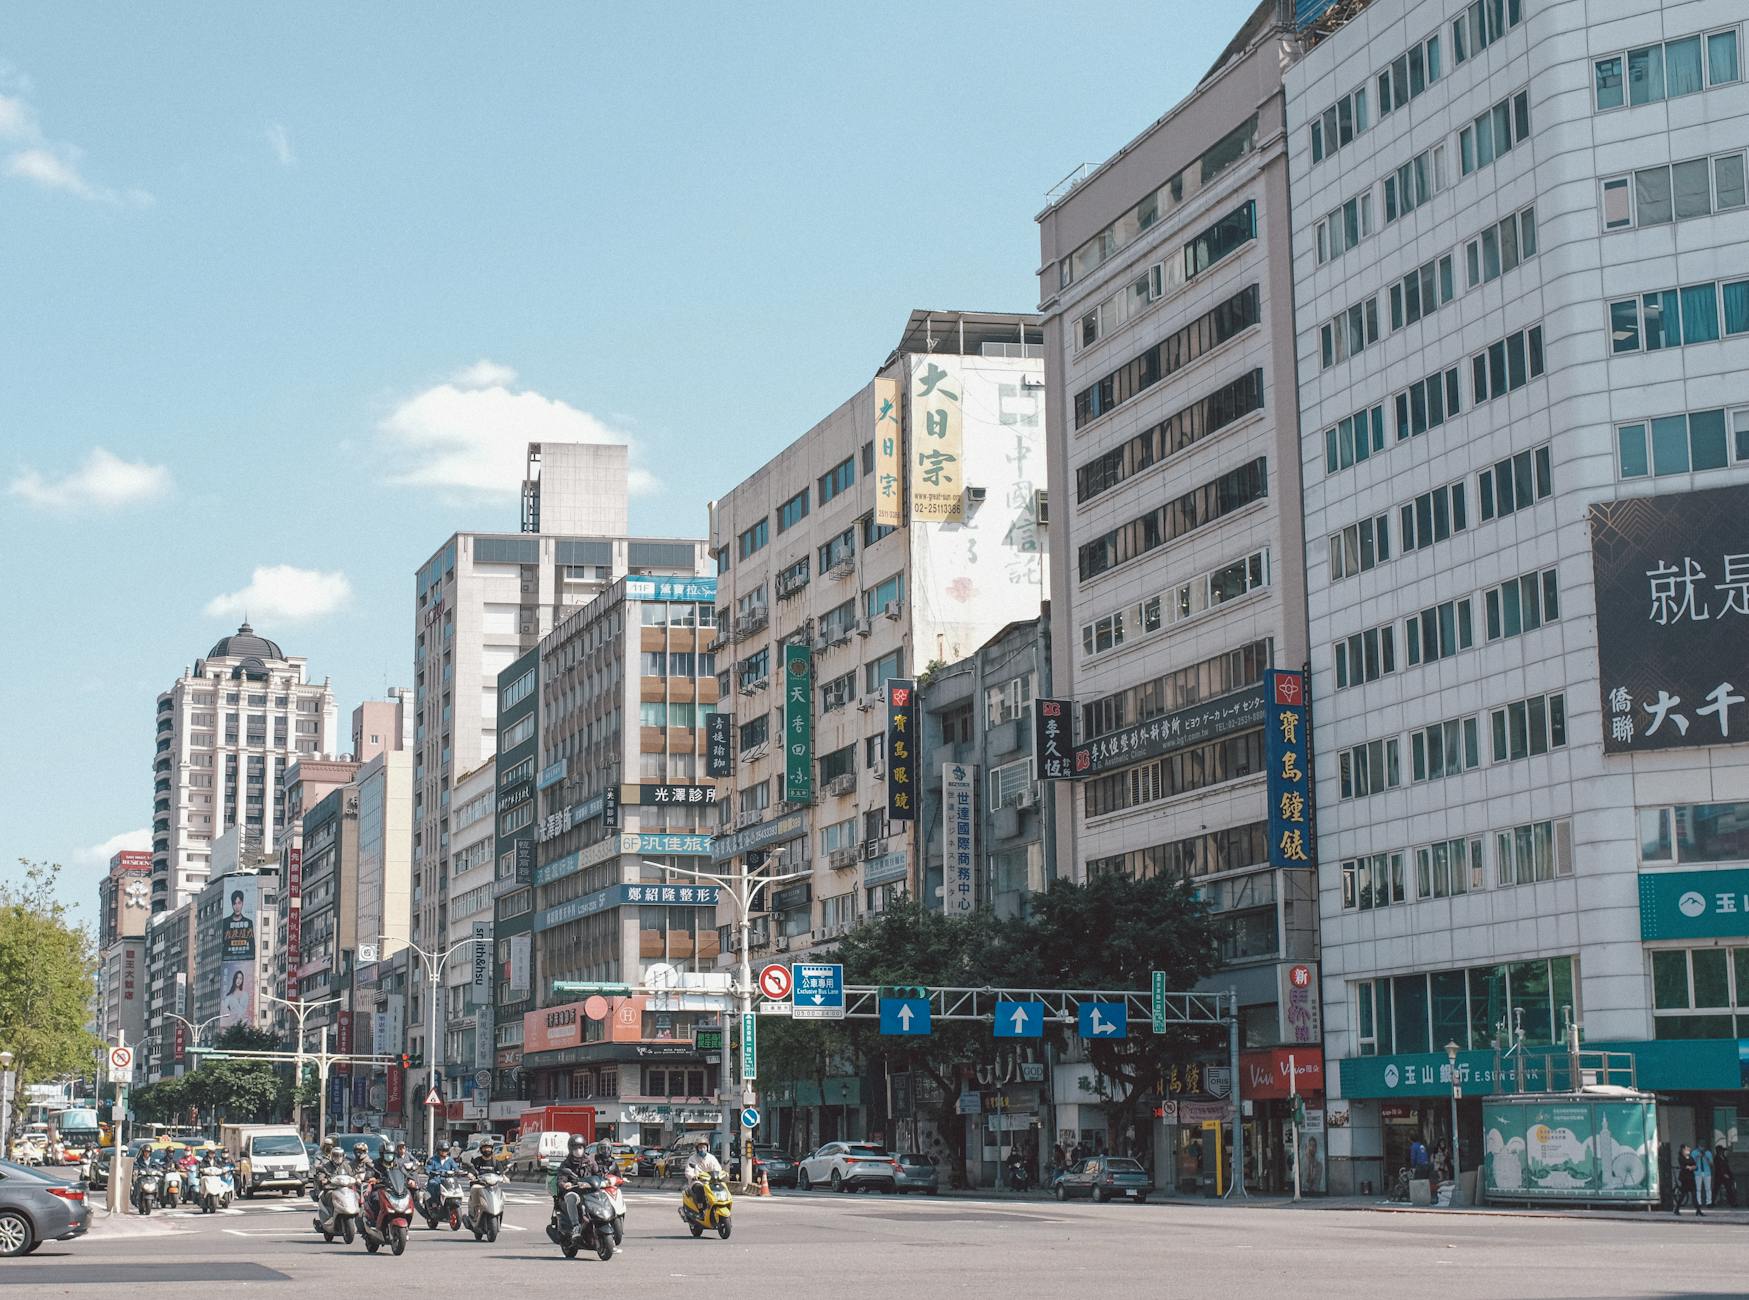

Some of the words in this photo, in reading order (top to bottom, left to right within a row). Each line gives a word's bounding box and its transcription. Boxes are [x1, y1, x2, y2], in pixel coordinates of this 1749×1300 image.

[879, 398, 899, 498] 大日宗
[915, 362, 959, 487] 大日宗
[914, 503, 961, 514] 02-25113386
[790, 686, 808, 784] 天香回味
[1609, 685, 1634, 743] 僑聯
[1643, 682, 1745, 737] 大千
[893, 714, 910, 809] 寶島眼鏡
[1279, 711, 1308, 862] 寶島鐘錶
[623, 837, 639, 850] 6F
[957, 791, 971, 911] 世達國際商務中心
[1296, 968, 1308, 985] 新
[1404, 1062, 1470, 1086] 玉山銀行
